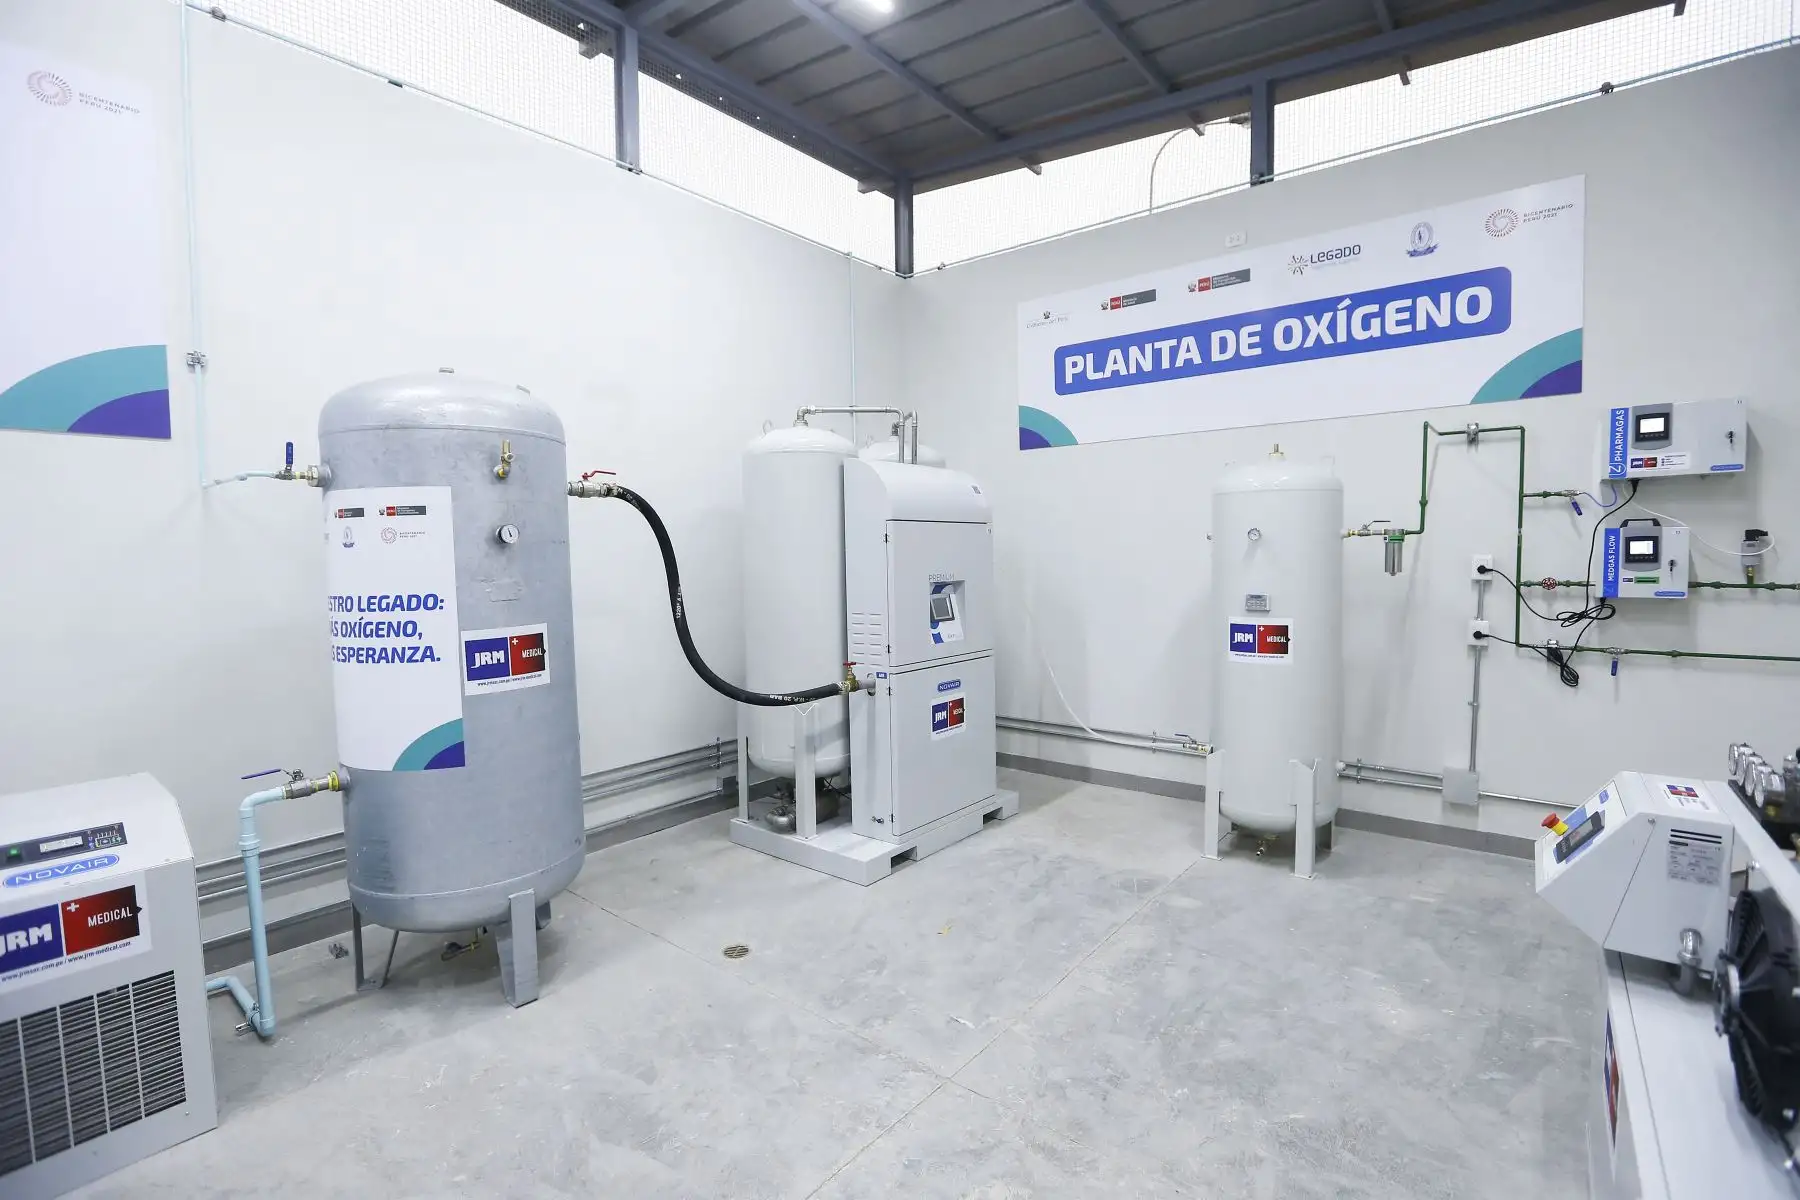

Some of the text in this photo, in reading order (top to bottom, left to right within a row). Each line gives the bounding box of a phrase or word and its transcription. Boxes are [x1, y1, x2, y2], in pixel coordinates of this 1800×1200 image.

[1523, 204, 1573, 217] BICENTENARIO
[1064, 285, 1494, 385] PLANTA DE OXÍGENO
[1614, 410, 1625, 461] PHARMAGAS
[1608, 535, 1616, 554] FLOW
[1607, 555, 1615, 581] MEDGAS
[357, 593, 445, 612] LEGADO:
[340, 616, 423, 640] OXÍGENO,
[1232, 632, 1287, 643] JRM MEDICAL
[336, 645, 441, 664] ESPERANZA.
[470, 647, 543, 669] JRM MEDICAL
[933, 710, 947, 723] JRM
[15, 857, 108, 884] NOVAIR
[87, 906, 133, 928] MEDICAL
